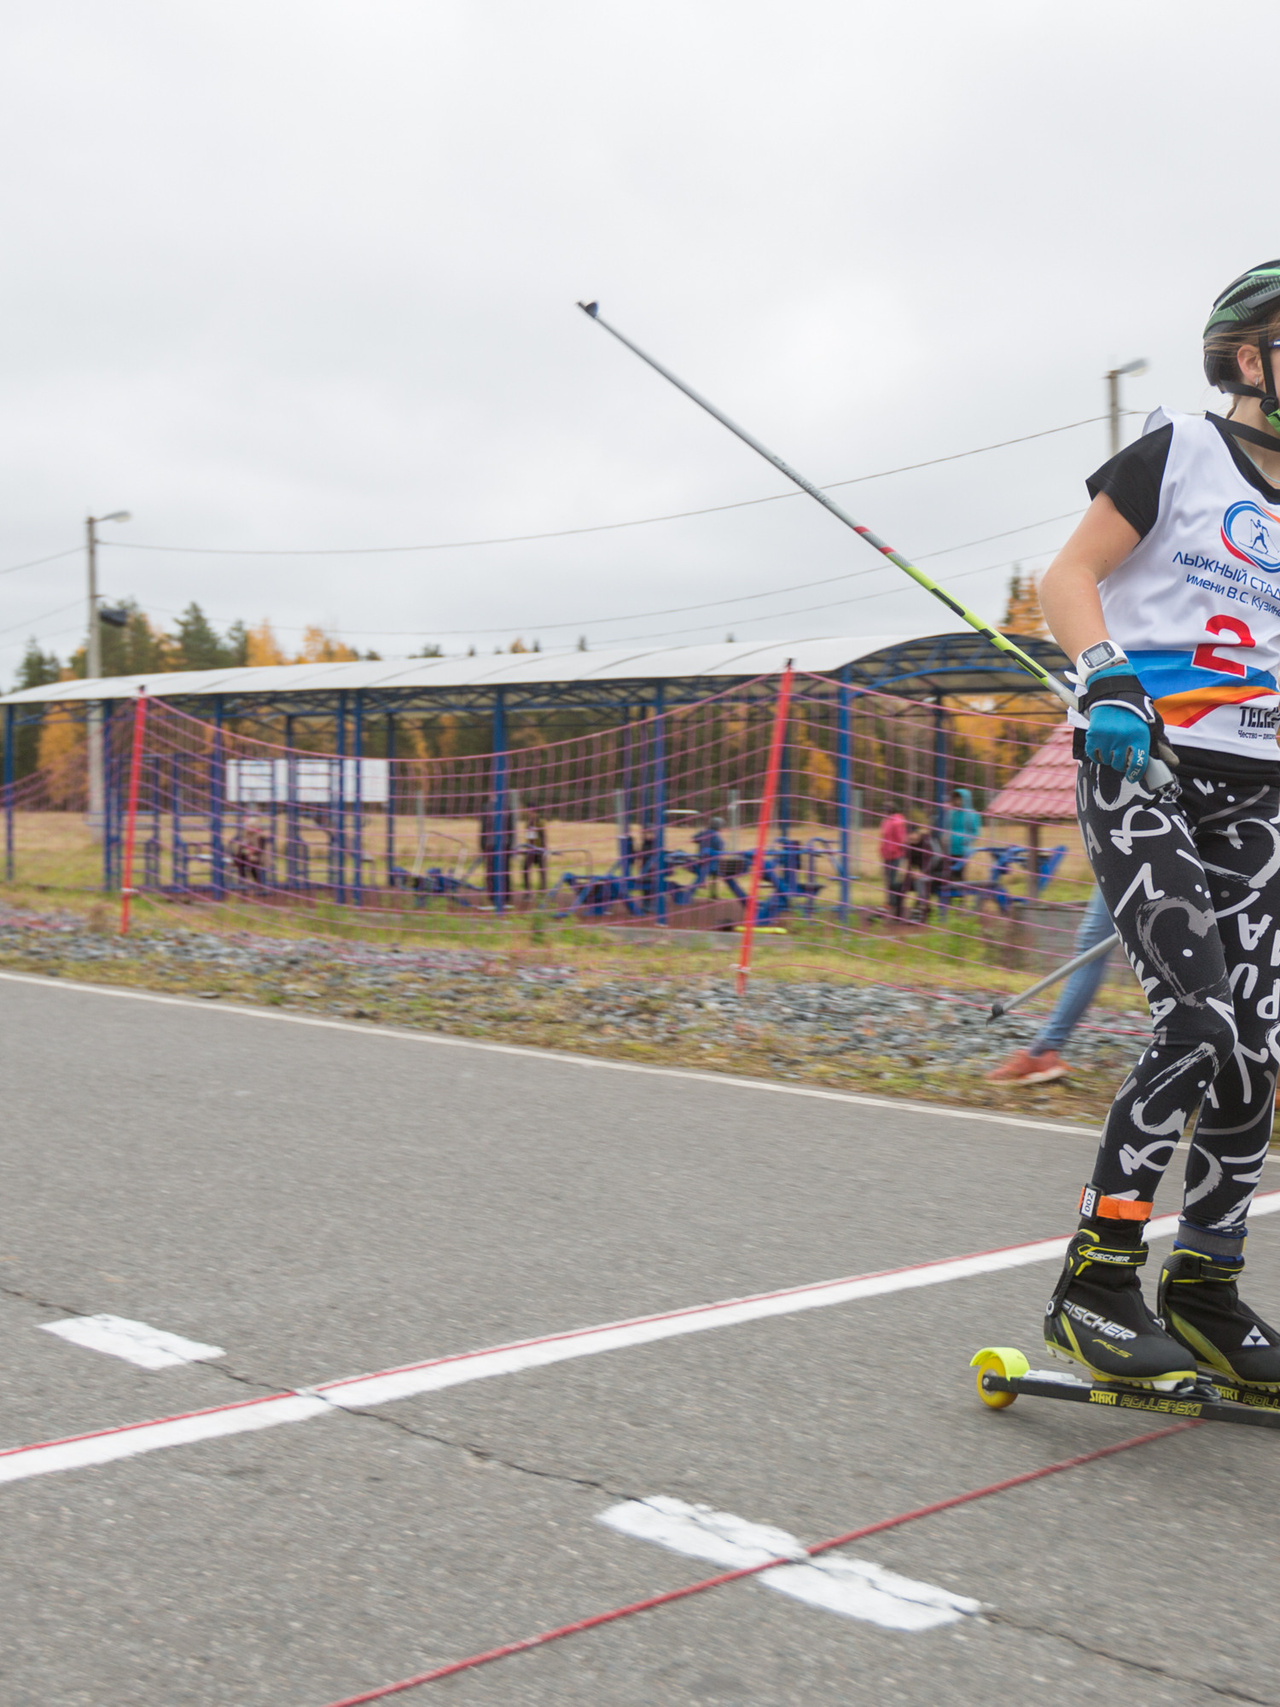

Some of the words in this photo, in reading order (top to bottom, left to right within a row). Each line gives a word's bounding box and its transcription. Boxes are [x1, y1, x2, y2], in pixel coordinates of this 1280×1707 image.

[1172, 551, 1249, 585] ЛЫЖНЫЙ
[1186, 573, 1225, 595] имени
[1191, 614, 1256, 678] 2
[1084, 1192, 1094, 1213] 002
[1086, 1251, 1131, 1263] FISCHER
[1089, 1389, 1119, 1406] START
